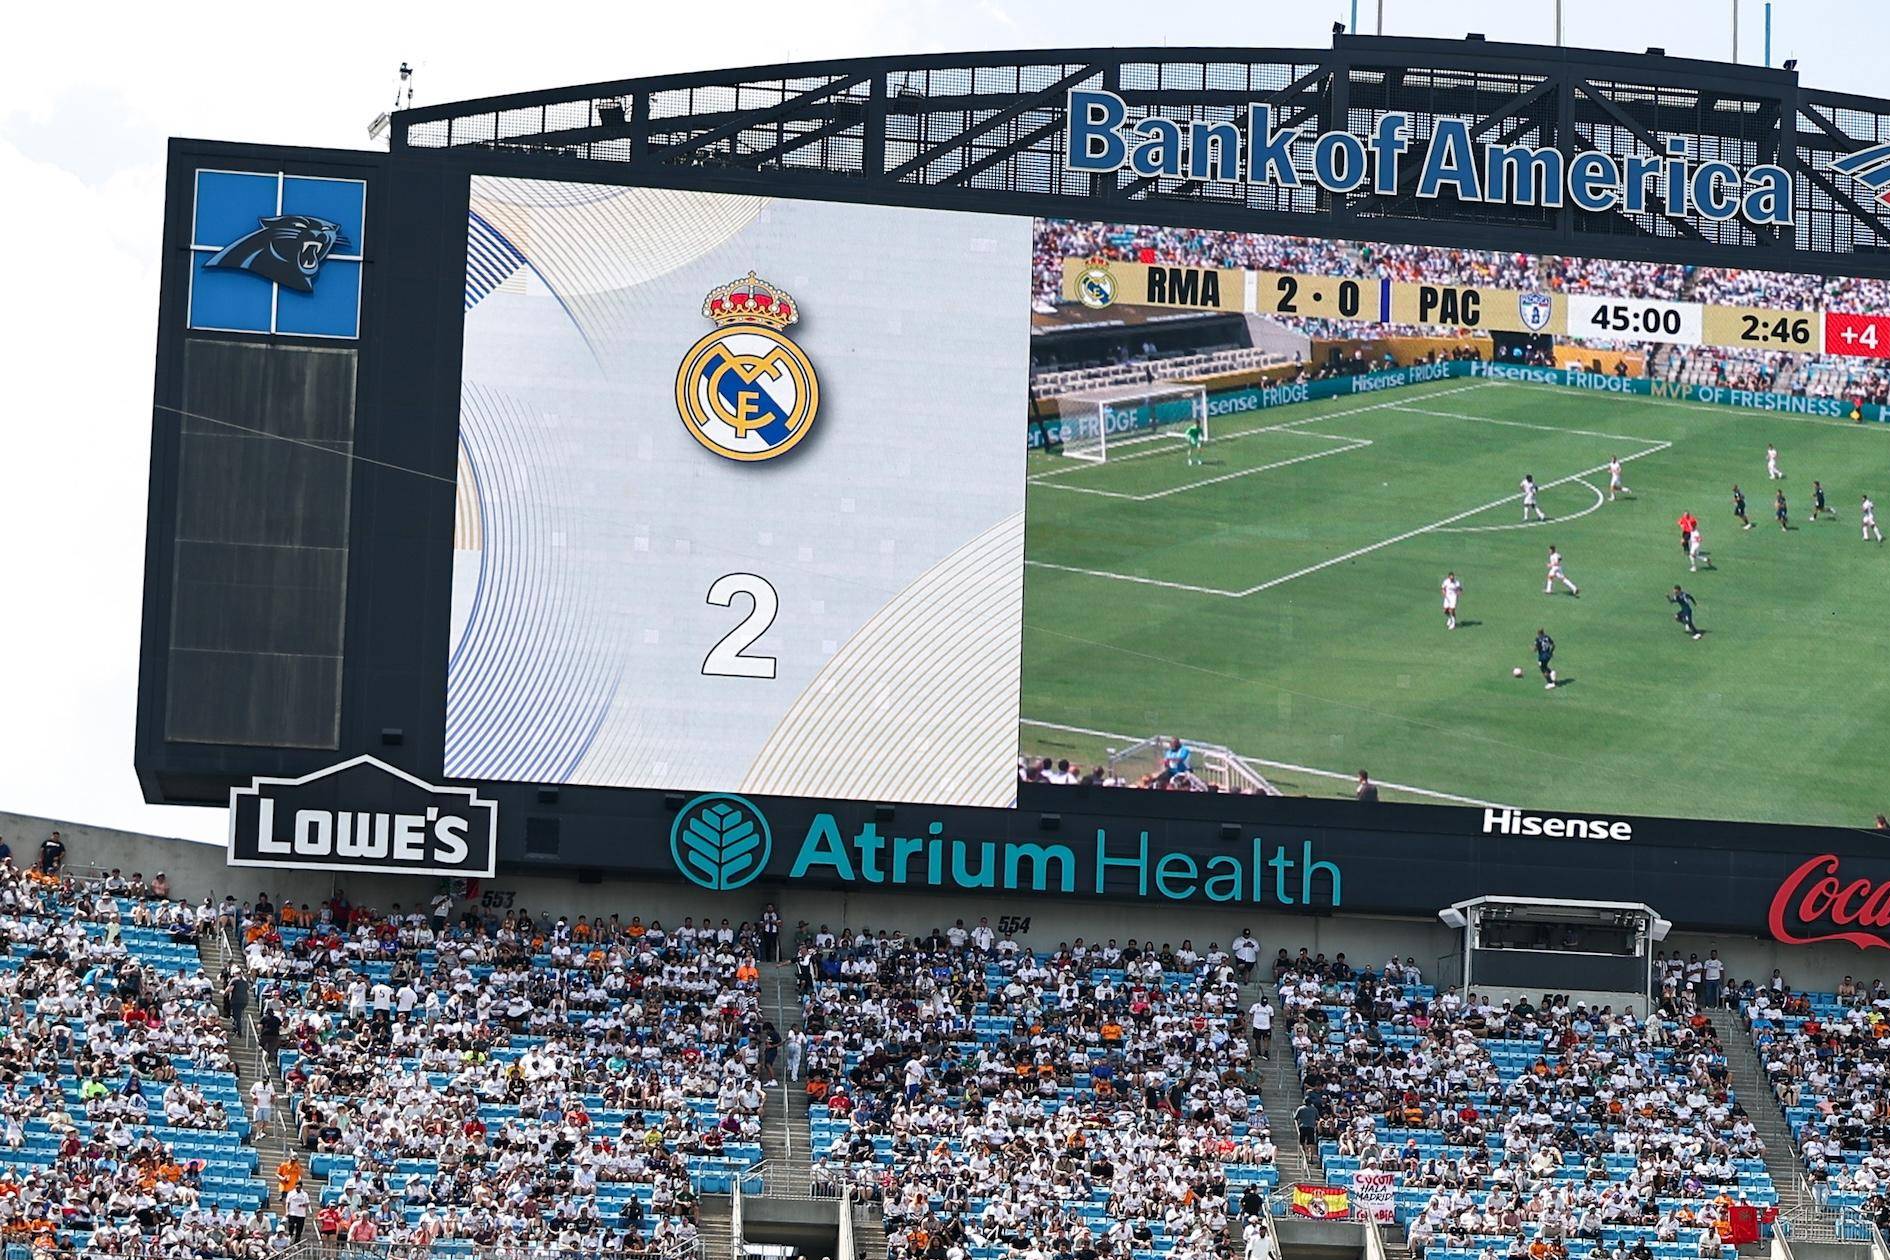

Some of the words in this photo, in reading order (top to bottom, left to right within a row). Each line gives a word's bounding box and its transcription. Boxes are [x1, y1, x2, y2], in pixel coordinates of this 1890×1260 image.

[1067, 87, 1302, 190] Bank
[1313, 111, 1409, 198] of
[1418, 118, 1794, 227] America
[1147, 266, 1220, 307] RMA
[1277, 277, 1298, 312] 2
[1339, 281, 1360, 317] 0
[1419, 286, 1481, 327] PAC
[1591, 304, 1682, 336] 45:00
[1741, 315, 1811, 344] 2:46
[1840, 323, 1880, 349] +4
[1352, 370, 1406, 393] Hisense
[1409, 361, 1451, 385] FRIDGE
[1470, 359, 1558, 386] Hisense
[1192, 394, 1258, 418] Hsense
[1262, 383, 1310, 408] FRIDGE
[1650, 380, 1693, 399] MVP
[1698, 385, 1724, 402] OF
[1730, 390, 1842, 418] FRESHNESS
[702, 572, 779, 680] 2
[258, 798, 471, 865] LOWE'S
[1483, 808, 1633, 842] Hisense
[789, 813, 1076, 893] Atrium
[1095, 829, 1342, 907] Health
[482, 891, 516, 908] 553
[998, 916, 1031, 933] 554
